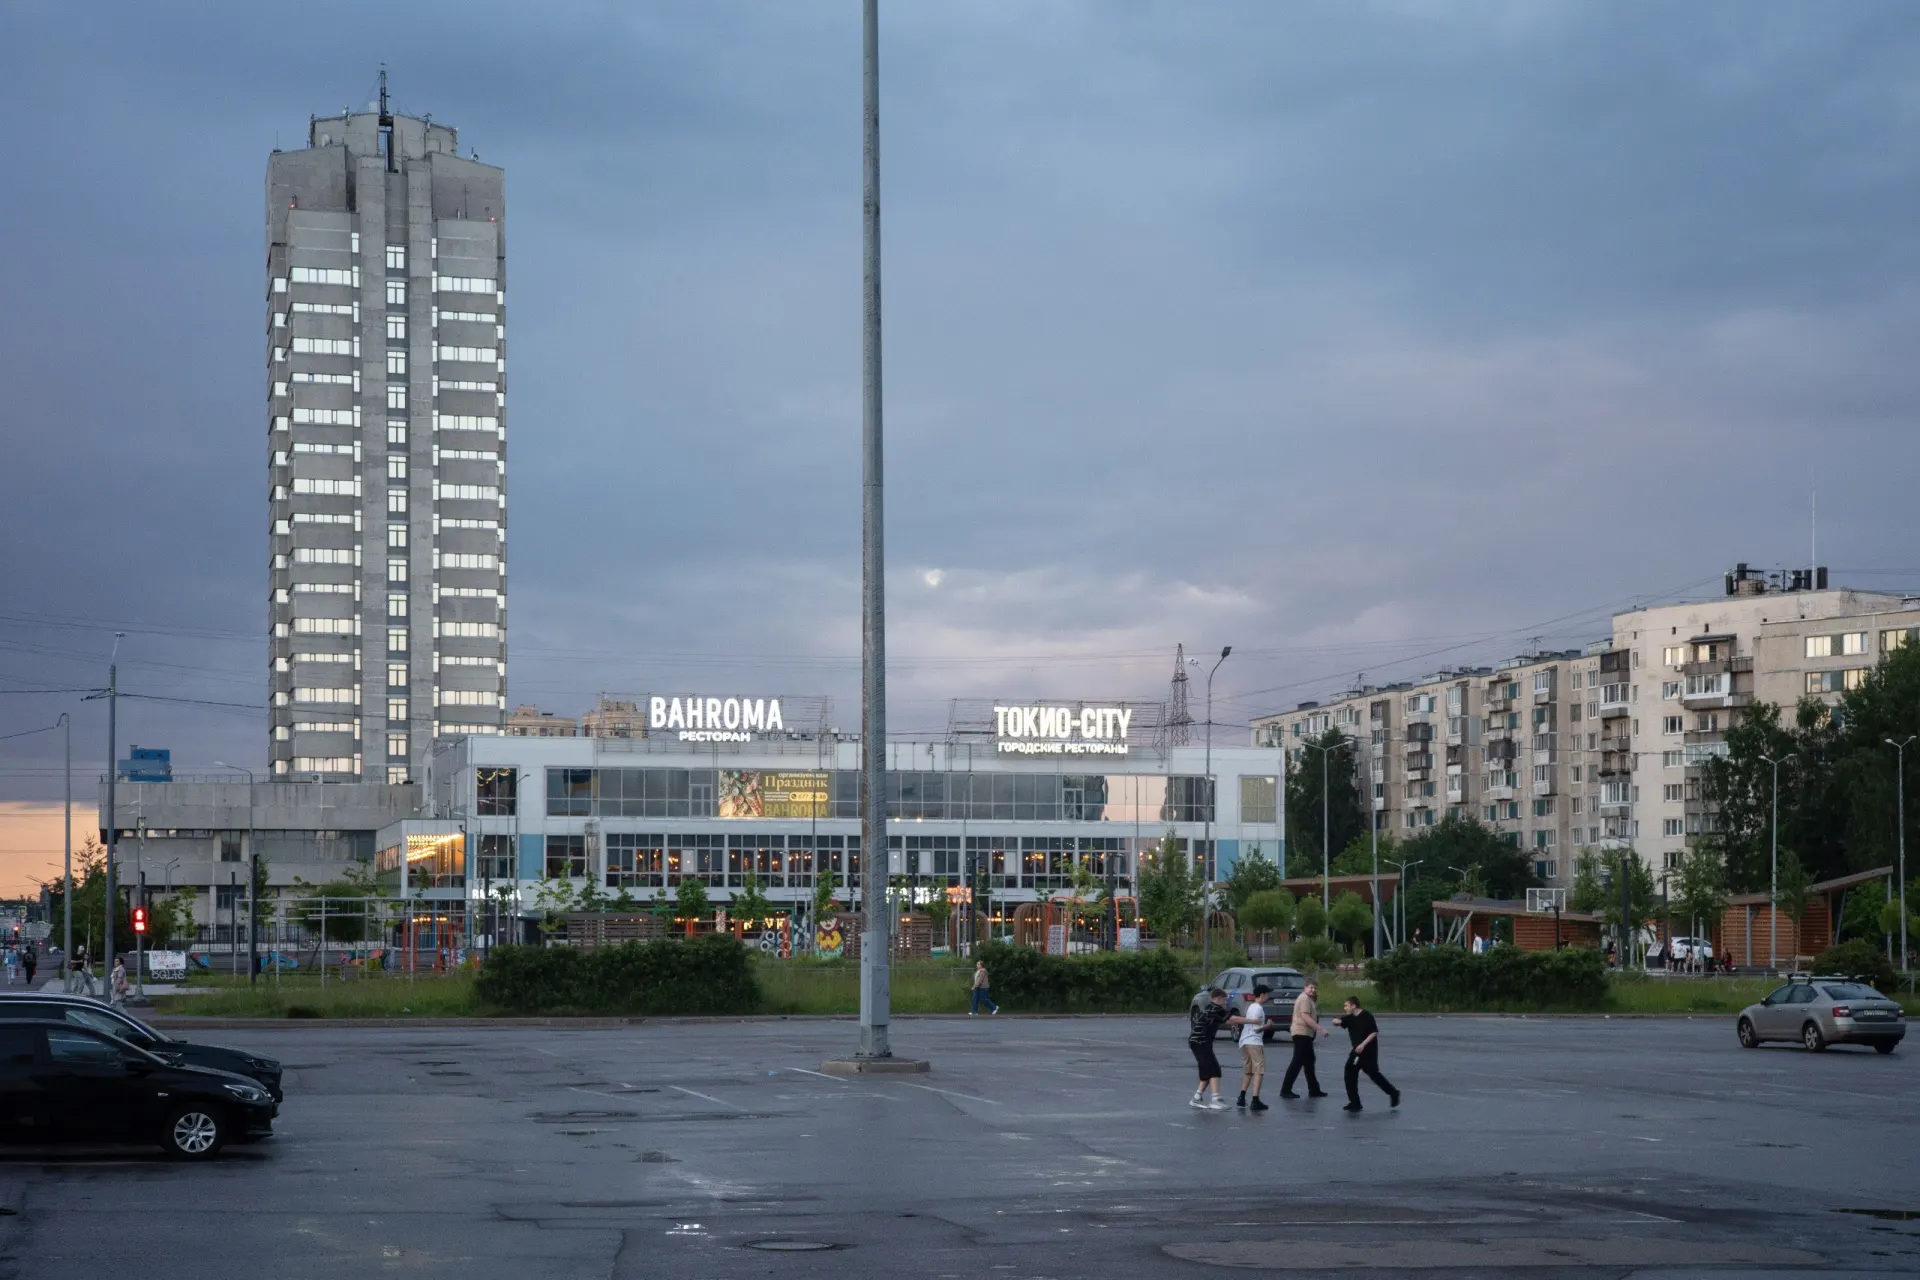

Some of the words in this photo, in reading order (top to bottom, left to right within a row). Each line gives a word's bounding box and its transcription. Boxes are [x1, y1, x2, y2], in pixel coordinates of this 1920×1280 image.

[650, 696, 783, 730] BAHROMA
[994, 706, 1132, 738] ТОКИО-CITY
[679, 731, 751, 742] РЕСТОРАН
[998, 741, 1063, 754] ГОРОДСКИЕ
[1065, 742, 1128, 754] РЕСТОРАНЫ
[764, 775, 829, 791] Праздник
[764, 803, 828, 817] BAHROMA
